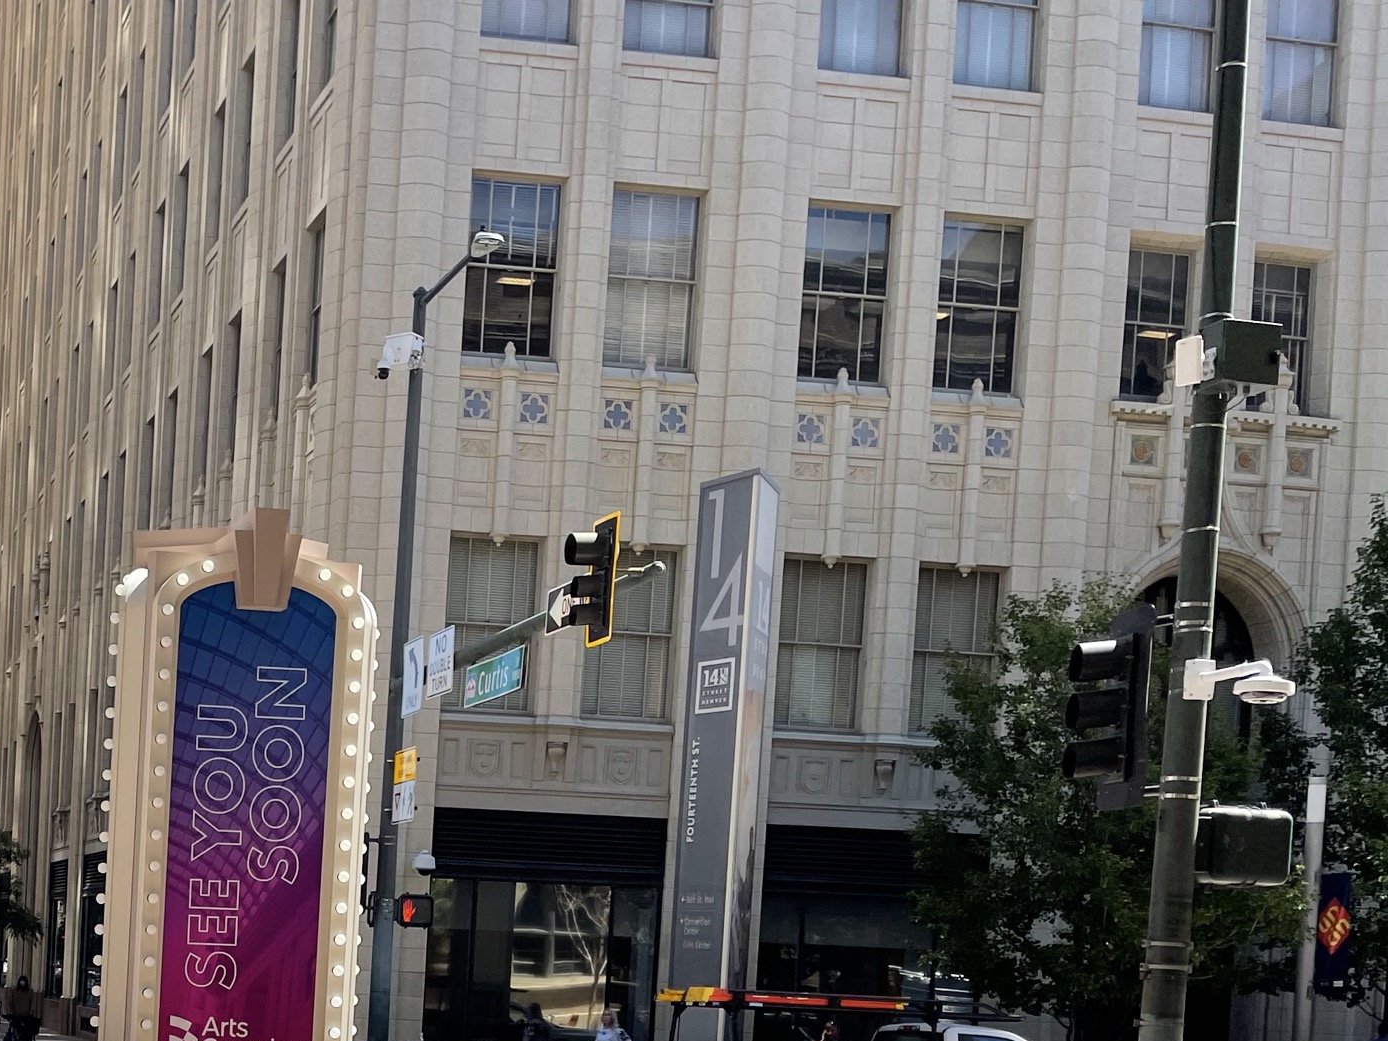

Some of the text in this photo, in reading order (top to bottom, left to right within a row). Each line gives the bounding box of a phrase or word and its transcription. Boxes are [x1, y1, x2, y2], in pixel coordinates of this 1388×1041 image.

[435, 634, 448, 656] NO
[429, 655, 451, 677] DOUBLE
[478, 661, 509, 696] Curtis
[431, 674, 448, 692] TURN
[247, 666, 308, 885] SOON
[686, 761, 699, 843] FOURTEENTH
[184, 704, 249, 990] SEE YOU
[202, 1016, 249, 1038] Arts
